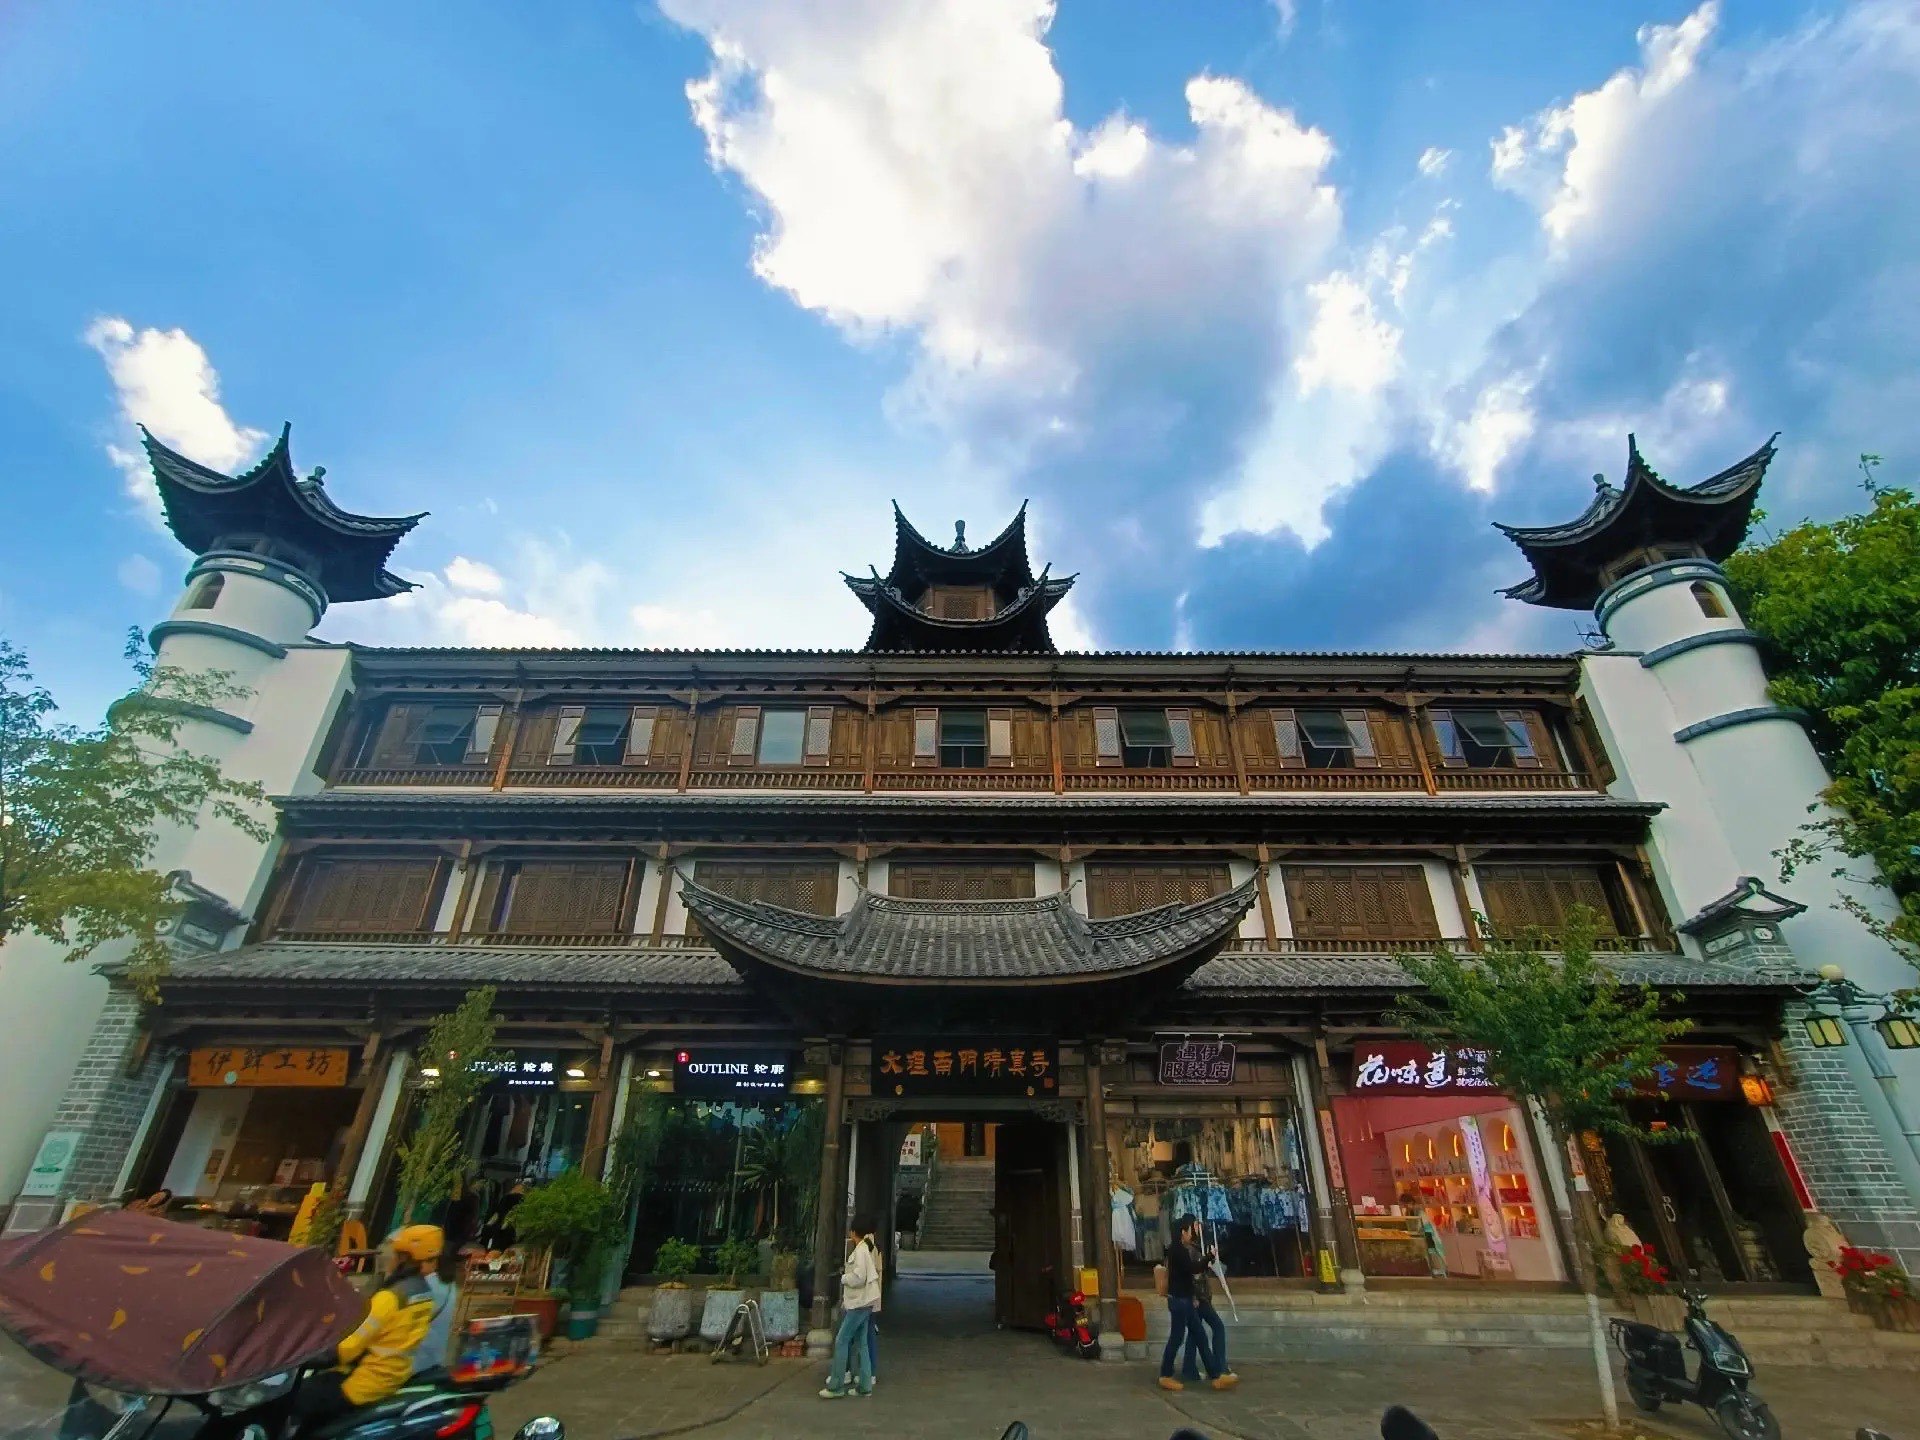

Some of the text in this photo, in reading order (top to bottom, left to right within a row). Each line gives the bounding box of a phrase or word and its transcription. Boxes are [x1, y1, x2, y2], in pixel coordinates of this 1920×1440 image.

[688, 1063, 785, 1075] OUTLINE 轮廓
[1164, 1061, 1231, 1079] 服装店
